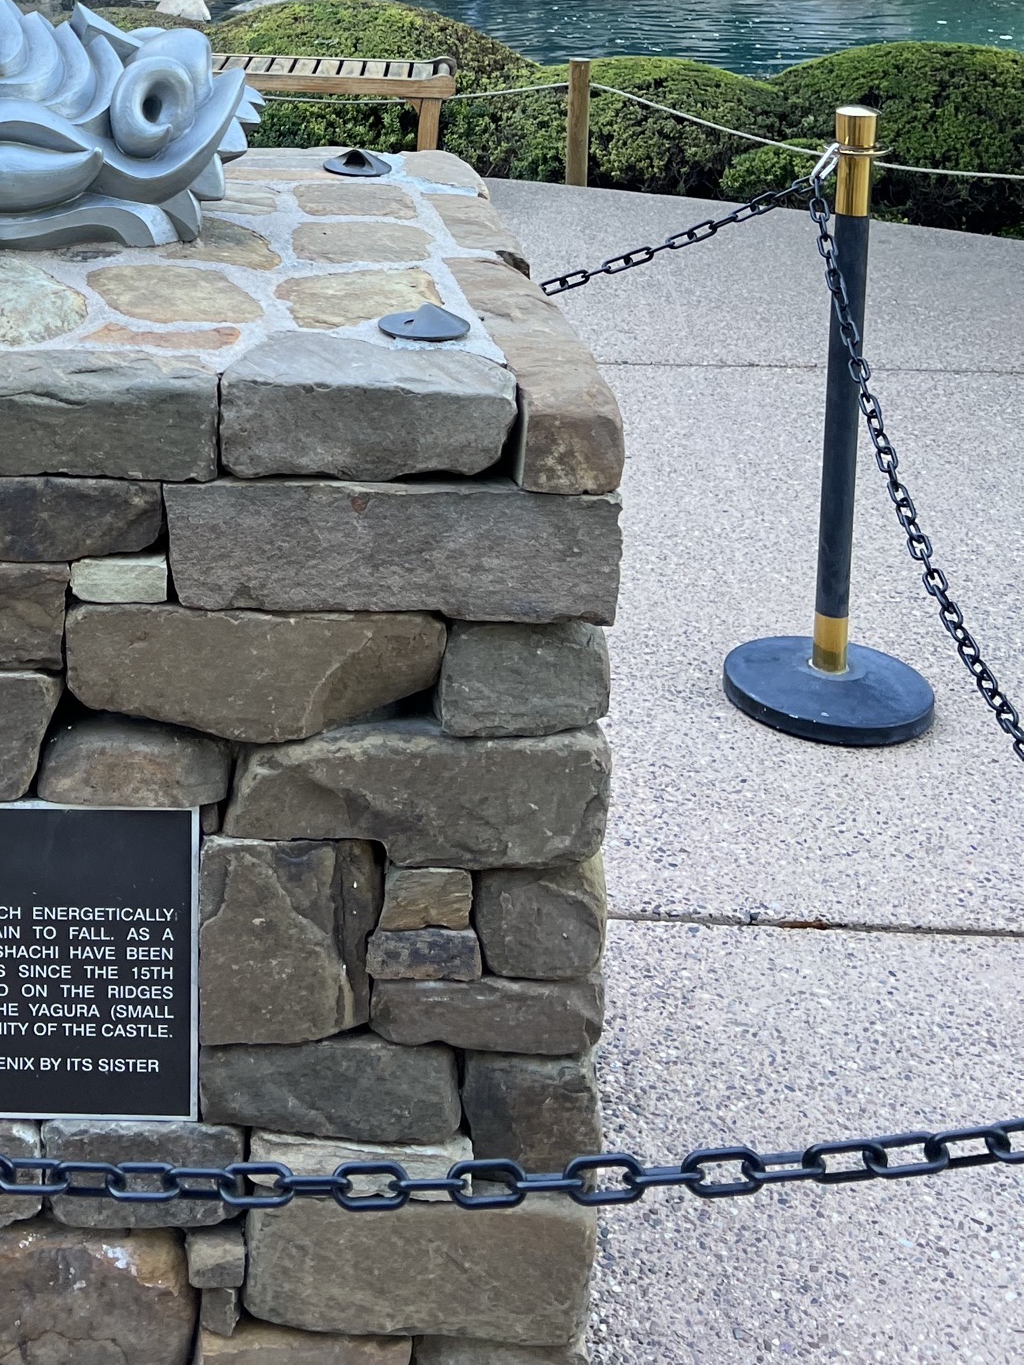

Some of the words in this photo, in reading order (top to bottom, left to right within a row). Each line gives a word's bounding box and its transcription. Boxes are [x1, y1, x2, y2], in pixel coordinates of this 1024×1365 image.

[33, 907, 174, 921] ENERGETICALLY
[32, 926, 56, 939] TO
[69, 927, 114, 940] FALL.
[127, 927, 150, 941] AS
[162, 928, 174, 941] A
[70, 946, 116, 960] HAVE
[127, 947, 173, 960] BEEN
[18, 964, 72, 978] SINCE
[83, 966, 118, 979] THE
[132, 967, 173, 980] 15TH
[21, 984, 47, 997] ON
[60, 985, 95, 998] THE
[108, 985, 173, 999] RIDGES
[28, 1003, 100, 1017] YAGURA
[111, 1005, 174, 1021] (SMALL
[34, 1023, 57, 1036] OF
[62, 1023, 96, 1036] THE
[102, 1024, 173, 1038] CASTLE.
[40, 1058, 61, 1071] BY
[67, 1058, 93, 1071] ITS
[98, 1058, 159, 1072] SISTER
